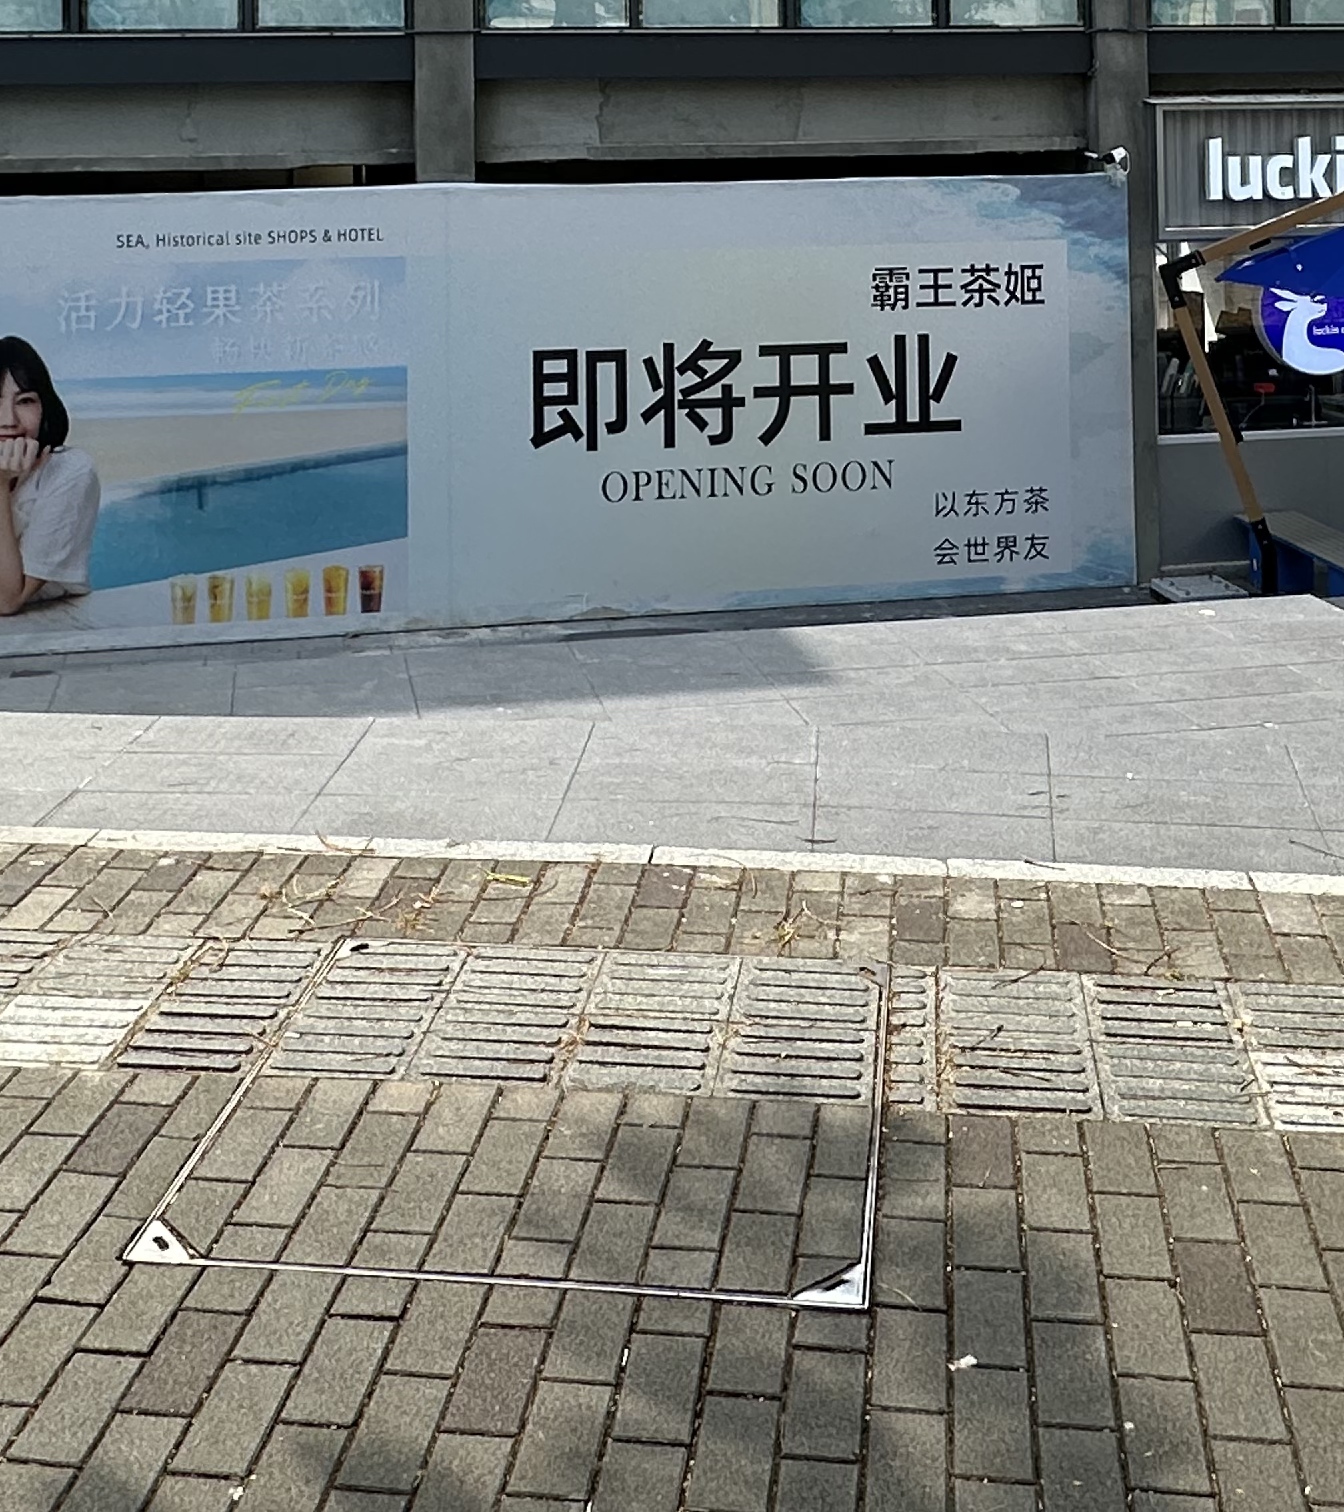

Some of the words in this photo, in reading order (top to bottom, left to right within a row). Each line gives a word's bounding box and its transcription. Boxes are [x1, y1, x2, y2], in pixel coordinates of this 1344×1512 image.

[116, 233, 150, 250] SEA,
[156, 231, 231, 248] Historical
[235, 230, 263, 246] site
[268, 228, 318, 245] SHOPS
[322, 229, 332, 243] &
[337, 227, 384, 243] HOTEL
[57, 278, 381, 334] 活力轻果茶系列
[871, 263, 1045, 312] 霸王茶姬
[1312, 324, 1339, 336] luckin
[529, 333, 962, 452] 即将开业
[601, 464, 775, 503] OPENING
[791, 459, 896, 494] SOON
[934, 486, 1051, 518] 以东方茶
[933, 533, 1051, 566] 会世界友
